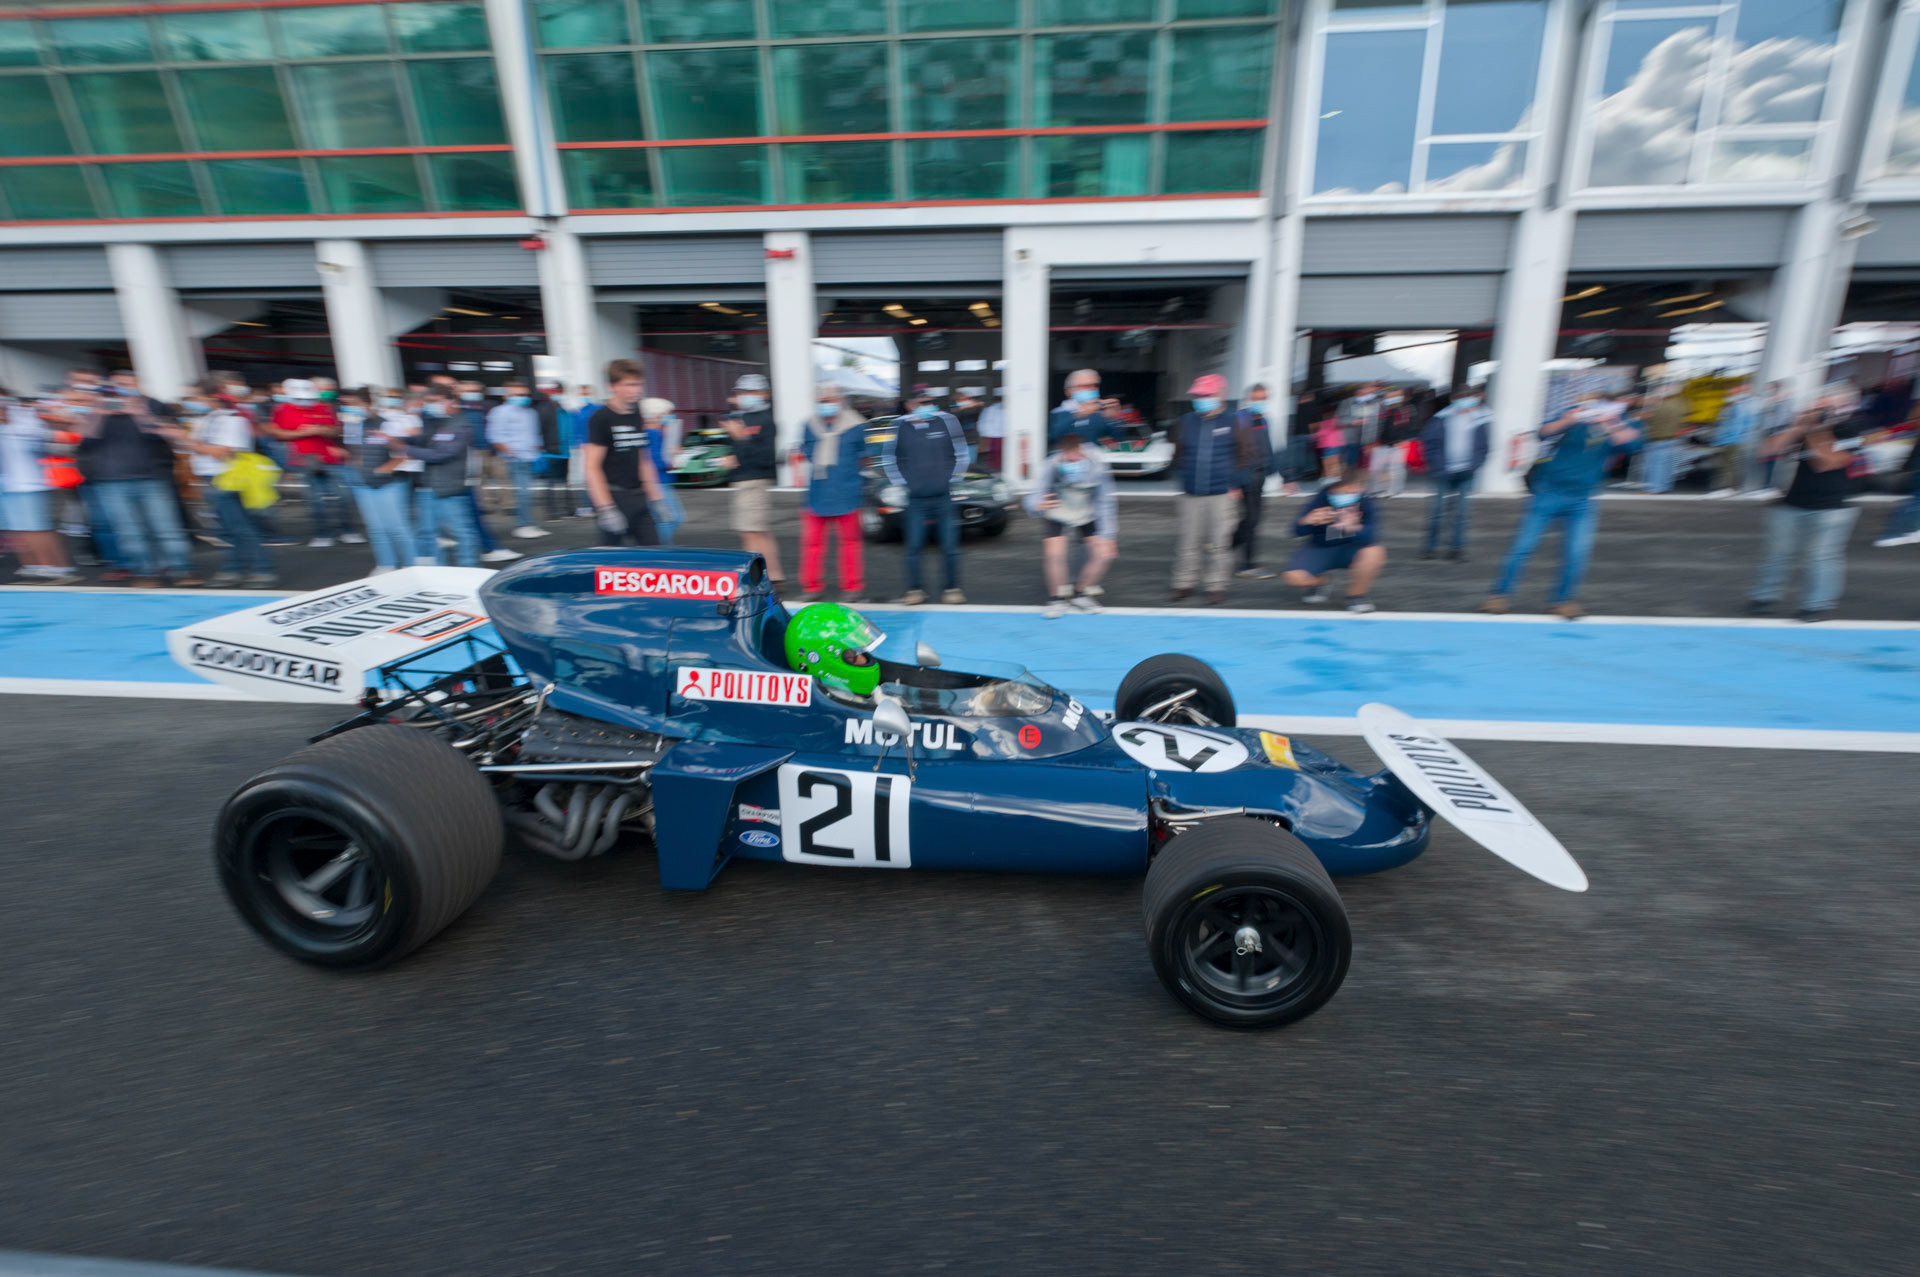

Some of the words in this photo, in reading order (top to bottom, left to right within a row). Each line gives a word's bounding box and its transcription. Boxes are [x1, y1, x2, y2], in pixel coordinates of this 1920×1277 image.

[599, 571, 734, 597] PESCAROLO
[269, 587, 382, 626] GOODYEAR
[281, 590, 468, 646] POLITOYS
[191, 643, 341, 687] GOODYEAR
[710, 671, 809, 704] POLITOYS
[1024, 728, 1036, 743] E
[1386, 733, 1514, 814] POLITOYS
[798, 770, 893, 862] 21
[747, 832, 772, 845] Ford
